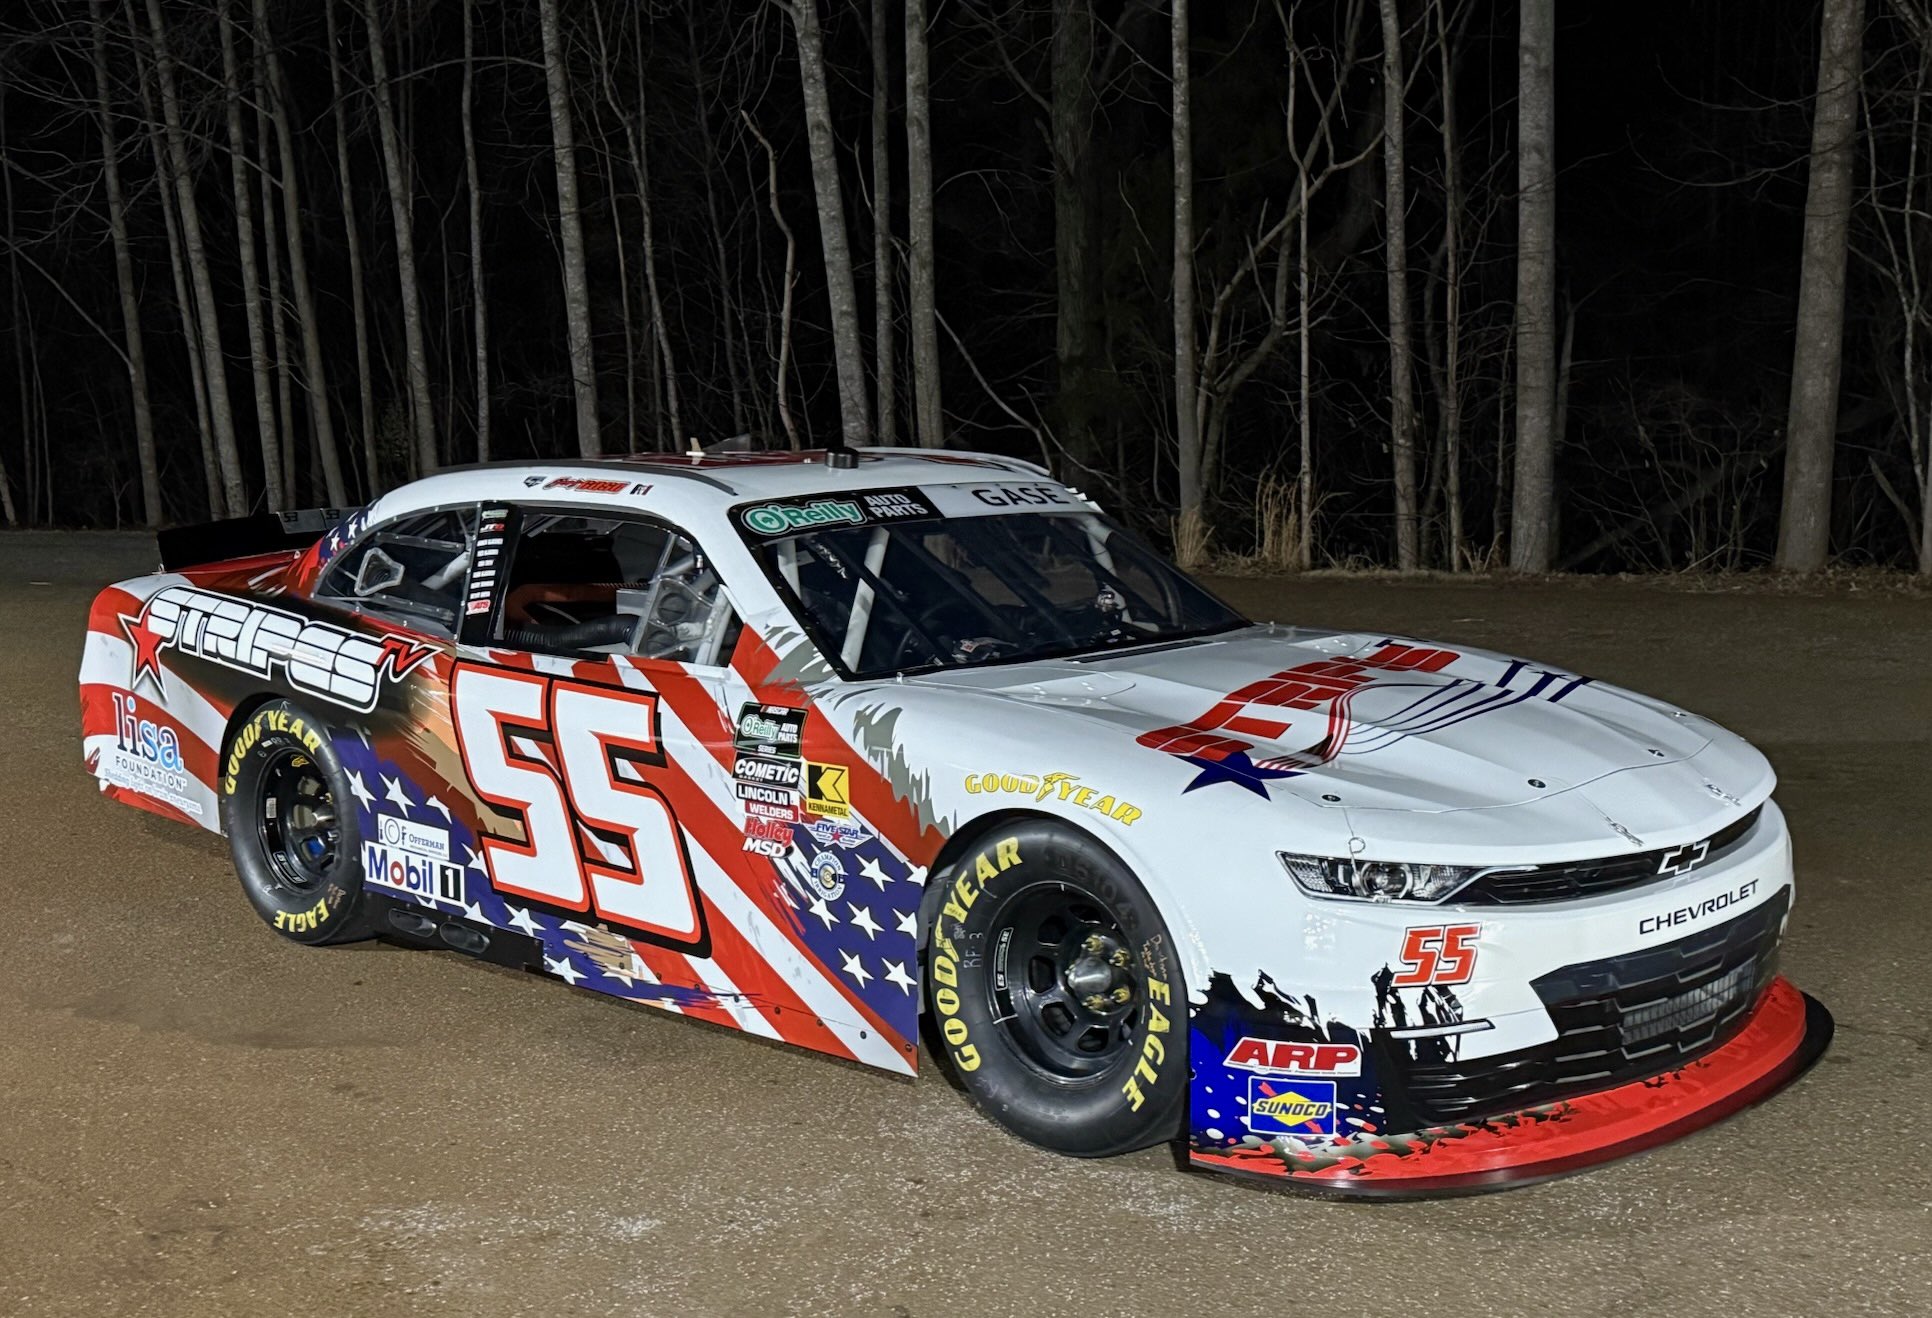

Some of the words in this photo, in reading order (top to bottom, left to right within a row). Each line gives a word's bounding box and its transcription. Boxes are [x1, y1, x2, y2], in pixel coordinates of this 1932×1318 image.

[864, 493, 911, 507] AUTO
[871, 502, 928, 519] PARTS
[971, 485, 1069, 507] GASE
[747, 499, 866, 535] O'Reilly
[148, 587, 387, 703] STRIPES
[376, 640, 428, 672] TV
[1136, 644, 1461, 761] STRIPS
[112, 692, 184, 773] lisa
[778, 732, 798, 743] PARTS
[781, 723, 798, 733] AUTO
[115, 755, 183, 790] FOUNDATION
[735, 759, 799, 783] COMETIC
[451, 660, 711, 950] 55
[738, 785, 788, 805] LINCOLN
[749, 802, 794, 820] WELDERS
[808, 801, 848, 817] KENNAMETAL
[744, 815, 794, 848] Holley
[816, 822, 836, 833] FIVE
[742, 837, 787, 858] MSD
[368, 845, 434, 894] Mobil
[273, 897, 331, 934] EAGLE
[1639, 878, 1760, 935] CHEVROLET
[1390, 922, 1482, 988] 55
[1122, 976, 1171, 1113] EAGLE
[1230, 1038, 1359, 1071] ARP
[1256, 1100, 1329, 1117] SUNOCO
